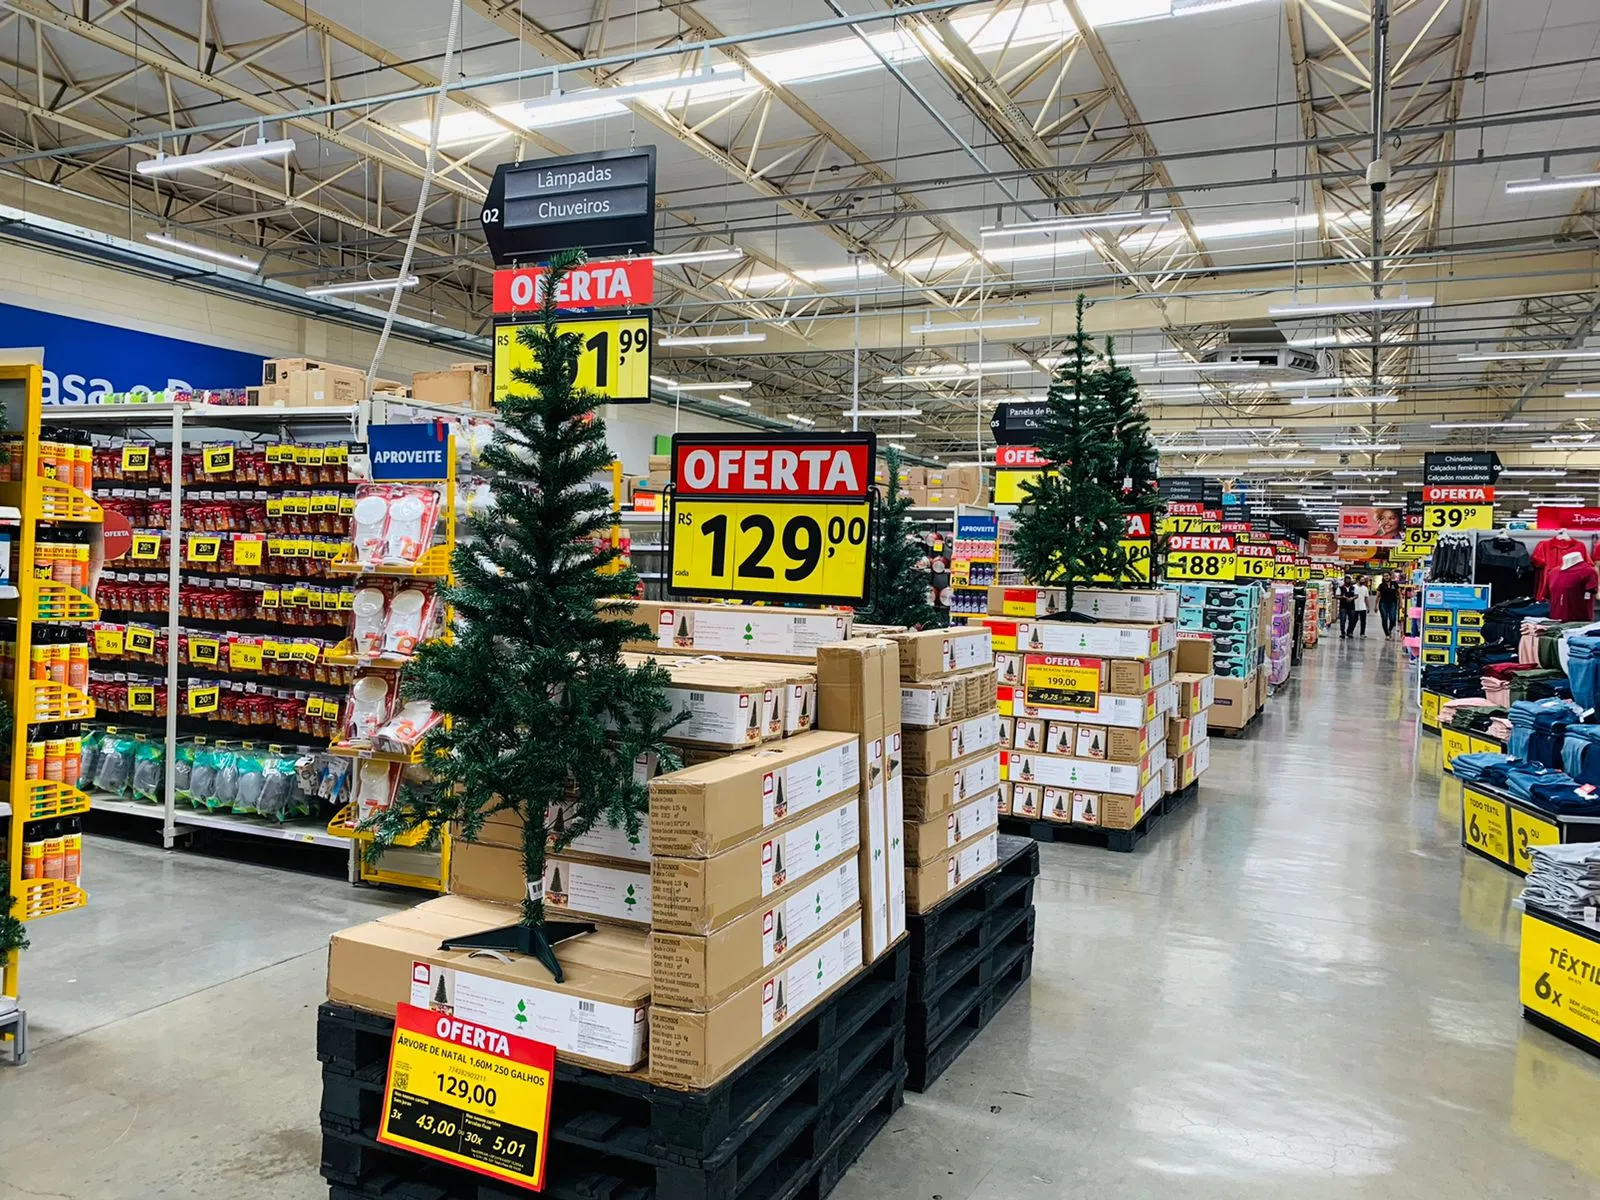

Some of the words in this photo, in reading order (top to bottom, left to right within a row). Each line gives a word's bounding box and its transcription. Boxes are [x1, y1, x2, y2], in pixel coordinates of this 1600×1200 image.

[537, 165, 612, 189] Lâmpadas
[482, 207, 499, 224] 02
[538, 198, 610, 219] Chuveiros
[1009, 407, 1033, 416] Panela
[990, 420, 1000, 428] 05
[374, 450, 442, 464] APROVEITE
[683, 449, 859, 491] OFERTA
[1430, 464, 1456, 472] Calçados
[1430, 488, 1486, 500] OFERTA
[1168, 503, 1198, 513] FERTA
[1202, 511, 1217, 519] RTA
[1343, 515, 1368, 524] BIG
[960, 525, 995, 533] APROVEITE
[678, 512, 692, 526] R$
[701, 514, 866, 582] 129,00
[1170, 536, 1231, 550] OFERTA
[1237, 545, 1273, 558] FERTA
[1276, 554, 1292, 563] RTA
[675, 569, 689, 577] cada
[1044, 656, 1081, 667] OFERTA
[1047, 677, 1077, 687] 199,00
[1531, 828, 1540, 839] OU
[1517, 827, 1530, 860] 3
[1550, 947, 1600, 986] TÊXTIL
[1534, 971, 1563, 1008] 6x
[436, 1017, 510, 1057] OFERTA
[397, 1033, 429, 1054] ÁRVORE
[429, 1045, 440, 1056] DE
[441, 1049, 467, 1064] NATAL
[469, 1057, 493, 1072] 1,60M
[493, 1065, 509, 1077] 250
[511, 1069, 545, 1086] GALHOS
[437, 1073, 497, 1107] 129,00
[390, 1109, 402, 1120] 3x
[415, 1114, 456, 1137] 43,00
[464, 1131, 483, 1146] 30x
[492, 1136, 526, 1158] 5,01
